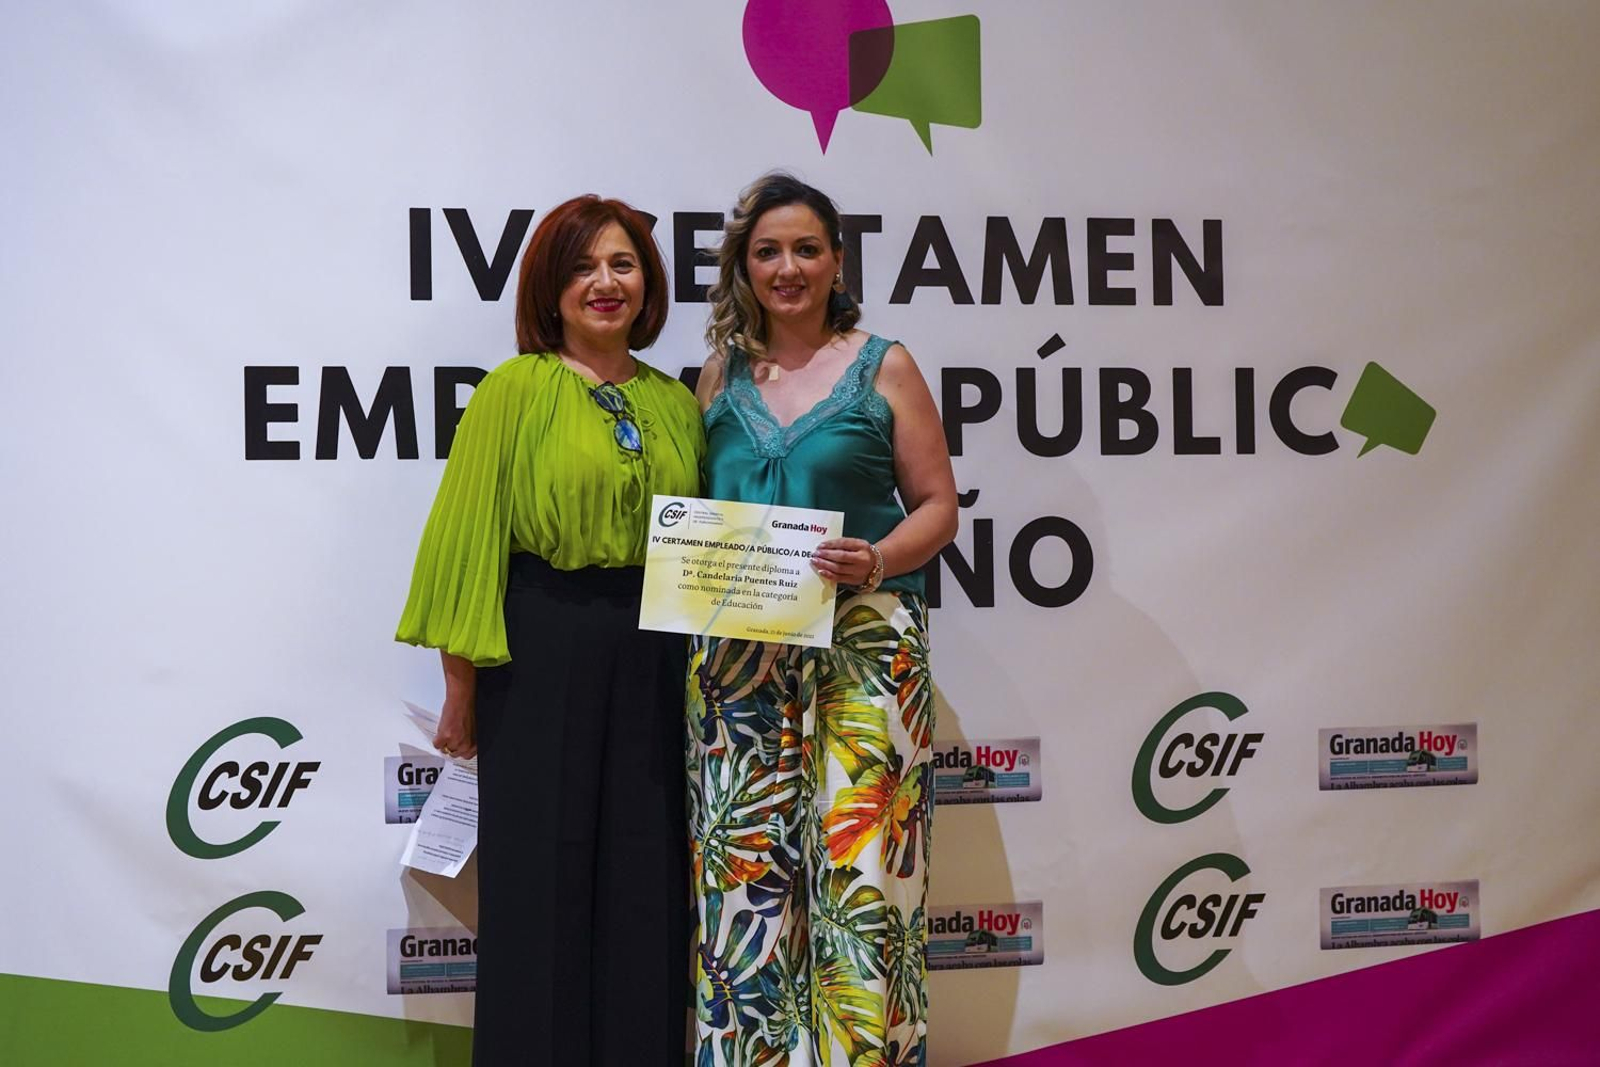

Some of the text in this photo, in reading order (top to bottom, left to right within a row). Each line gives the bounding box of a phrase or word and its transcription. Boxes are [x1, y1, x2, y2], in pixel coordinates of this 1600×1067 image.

[409, 207, 1225, 306] IV ETAMEN
[664, 508, 688, 520] CSIF
[771, 520, 828, 535] Granada Hoy
[662, 537, 703, 547] CERTAMEN
[704, 540, 755, 553] EMPLEADO/A
[757, 544, 800, 557] PÚBLICO/A
[681, 556, 691, 564] Se
[691, 558, 717, 568] otorga
[718, 559, 726, 568] el
[726, 560, 761, 572] presente
[761, 564, 794, 575] diploma
[696, 570, 743, 582] Candelaria
[744, 575, 777, 586] Puentes
[778, 579, 798, 589] Ruiz
[677, 583, 798, 602] como nominada en la categoría
[710, 597, 763, 611] de Educación
[1157, 732, 1265, 779] CSIF
[1329, 730, 1458, 756] Granada Hoy
[975, 746, 1018, 771] Hoy
[197, 760, 322, 811] CSIF
[1331, 888, 1459, 914] Granada Hoy
[977, 910, 1021, 936] Hoy
[1160, 893, 1266, 940] CSIF
[199, 933, 324, 984] CSIF
[400, 935, 478, 957] Grana
